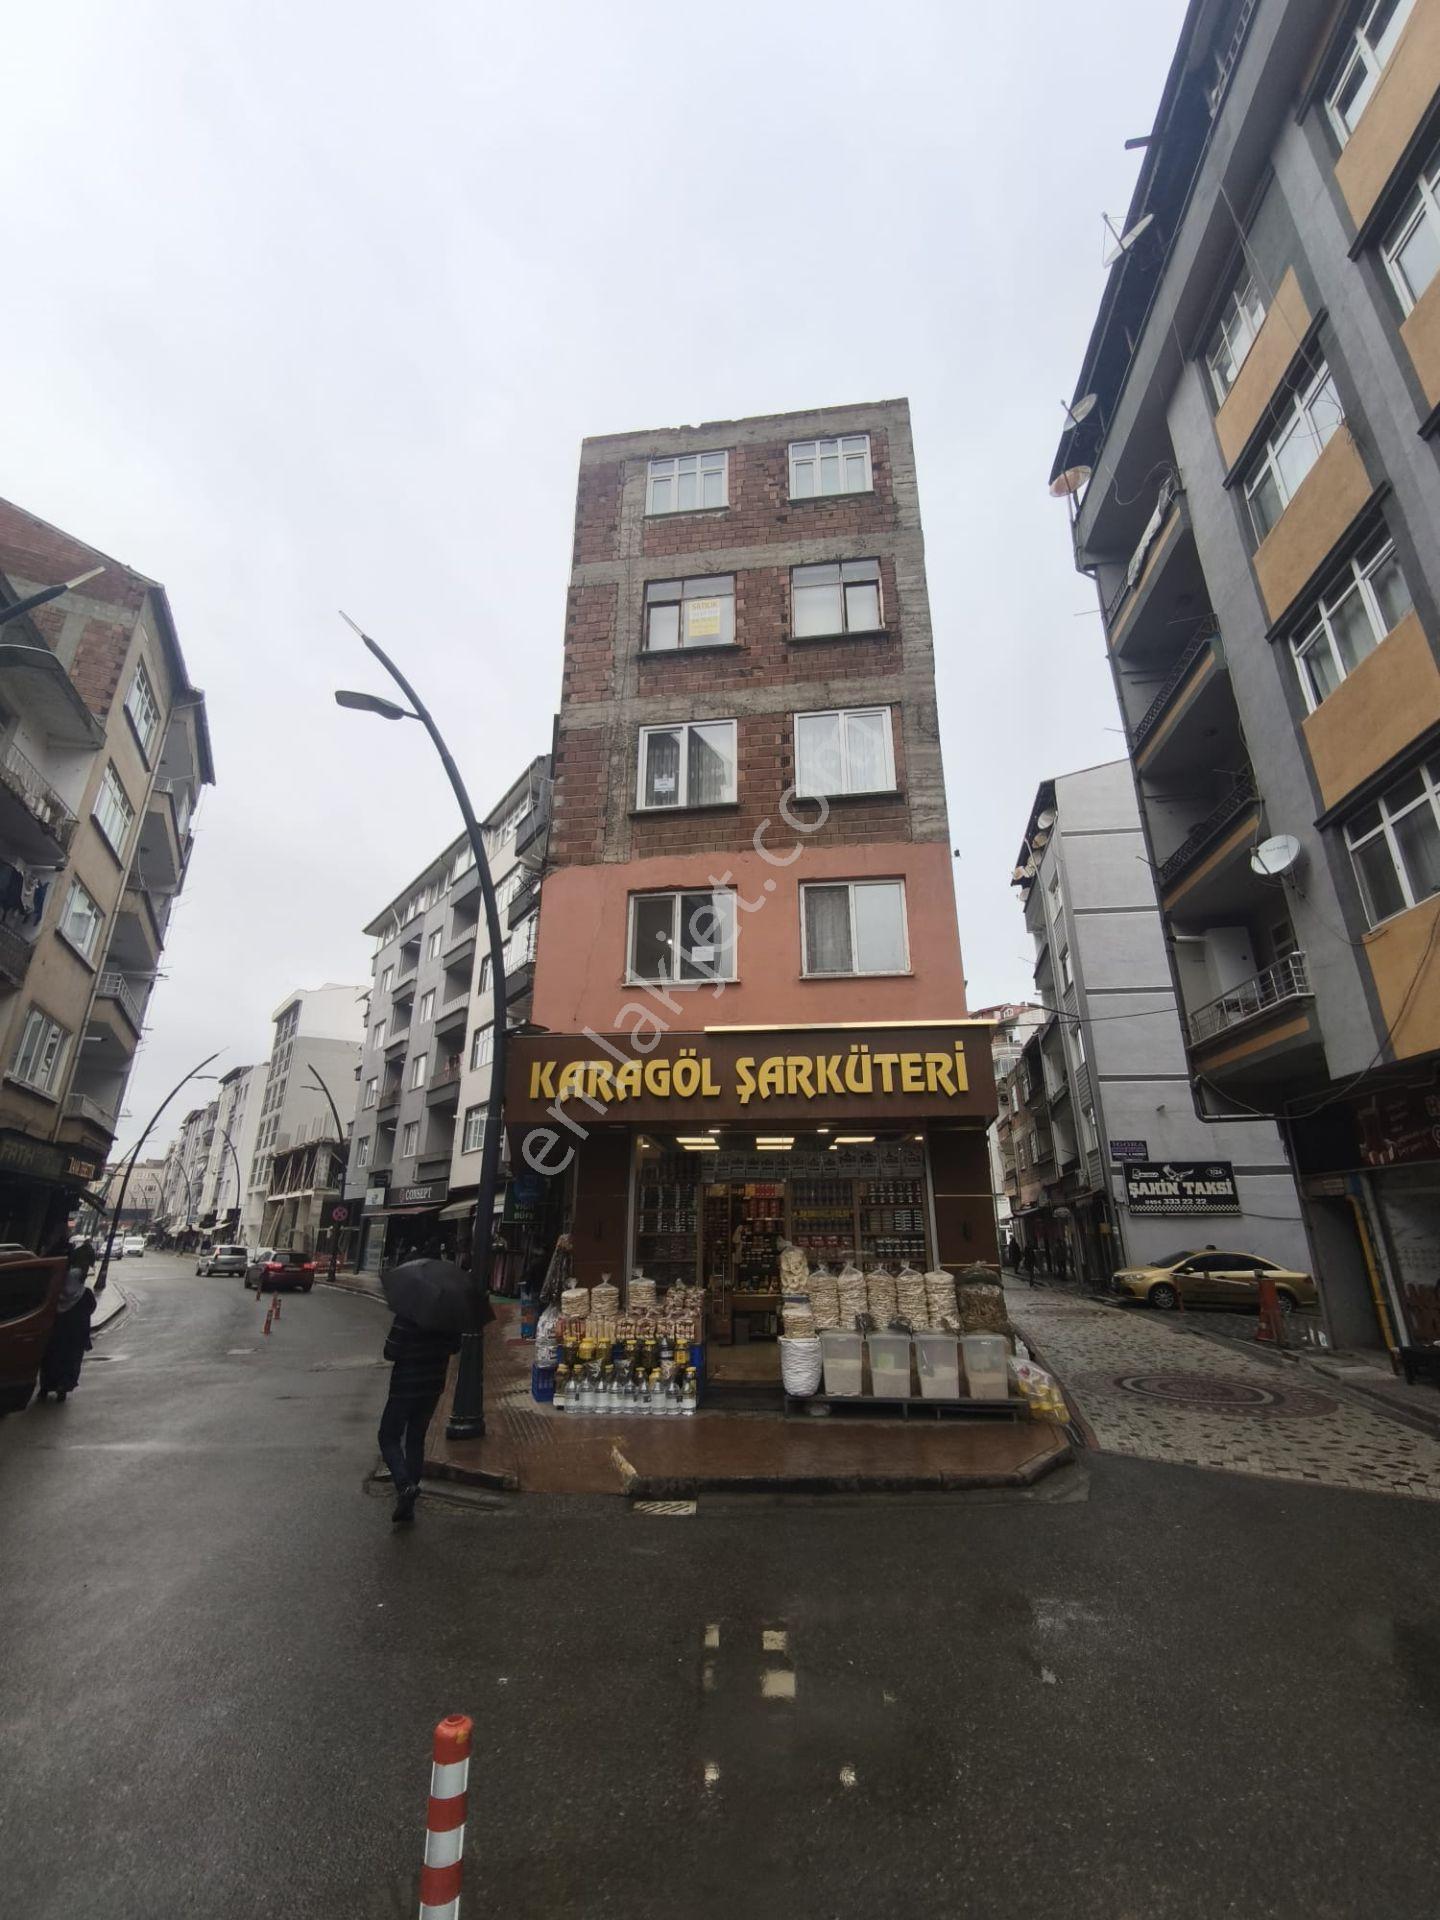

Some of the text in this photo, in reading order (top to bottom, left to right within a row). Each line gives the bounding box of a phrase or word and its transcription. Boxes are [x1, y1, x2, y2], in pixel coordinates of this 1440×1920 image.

[529, 1040, 970, 1105] KARAGÖL ŞARKÜTERİ
[1128, 1178, 1234, 1198] ŞAHİN TAKSİ
